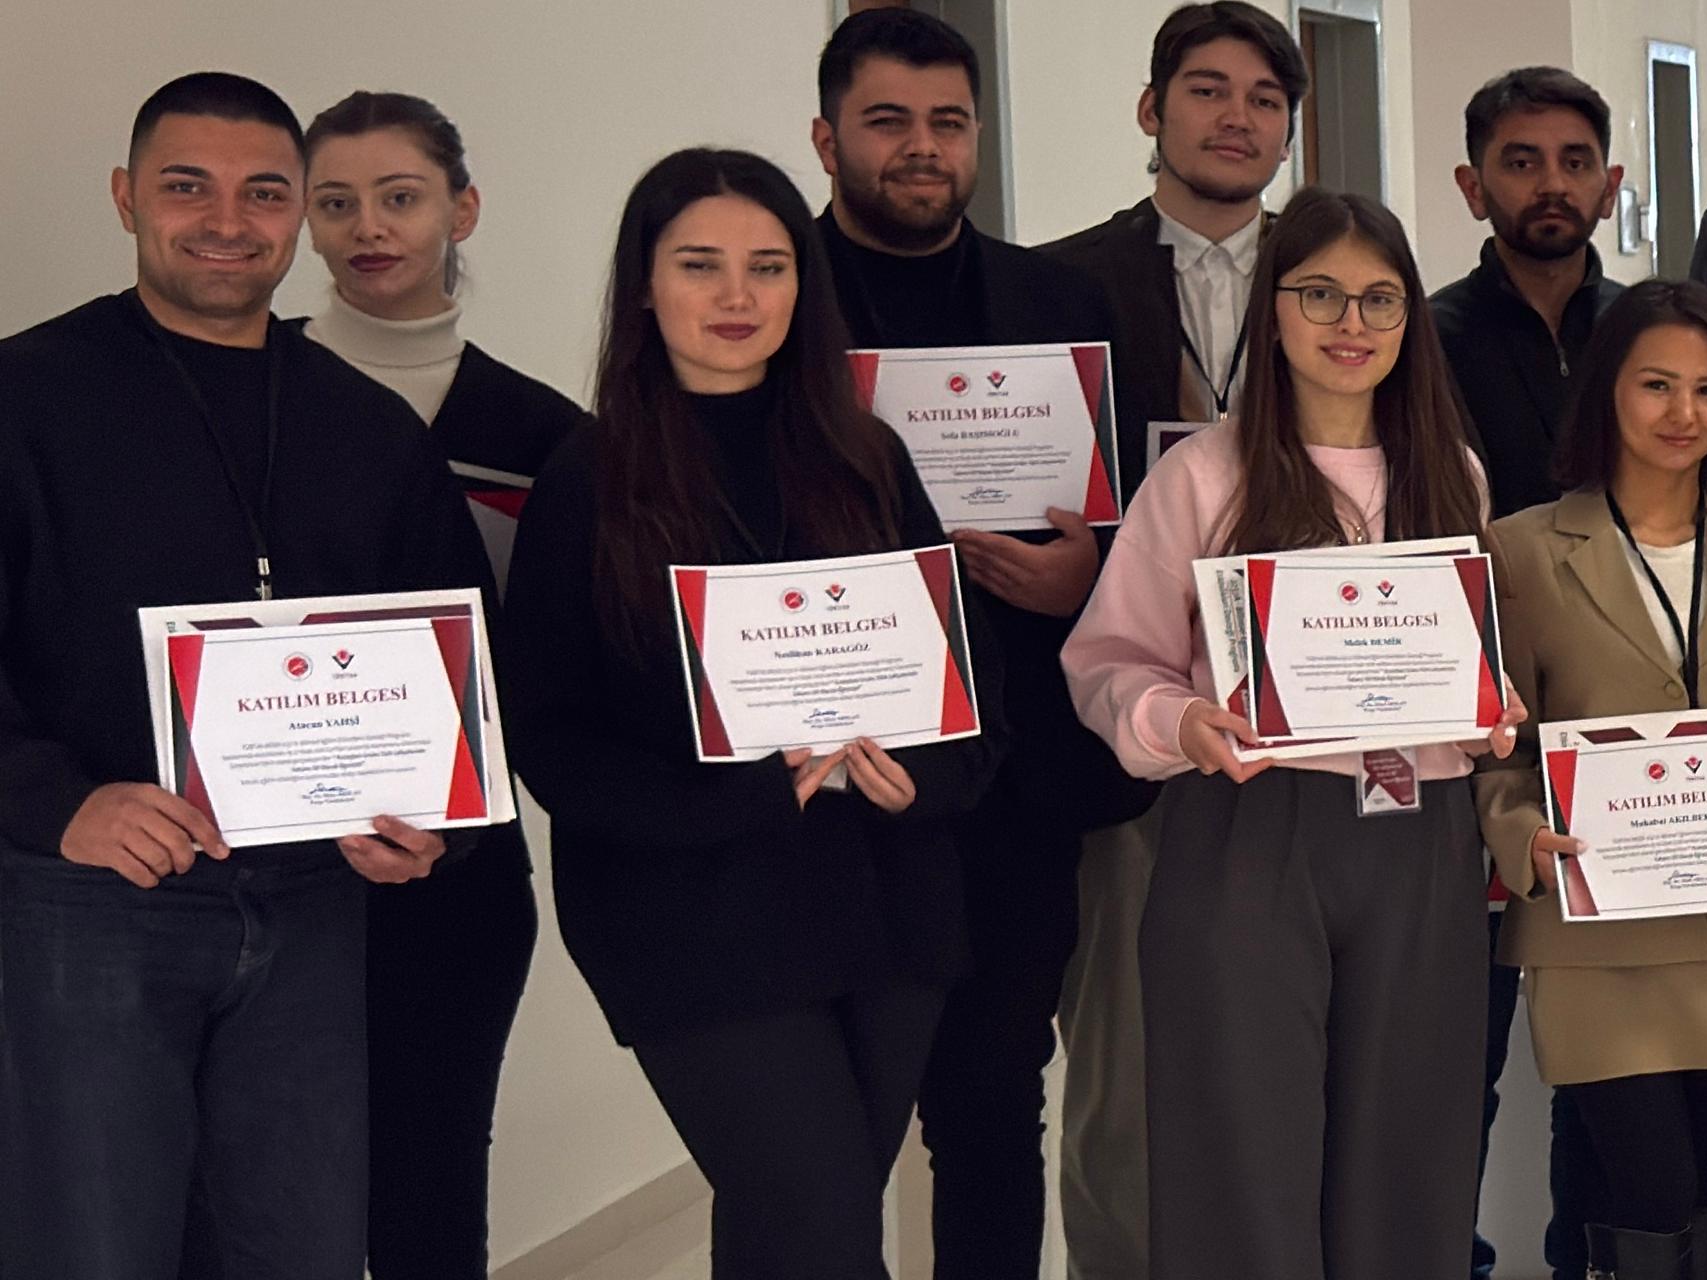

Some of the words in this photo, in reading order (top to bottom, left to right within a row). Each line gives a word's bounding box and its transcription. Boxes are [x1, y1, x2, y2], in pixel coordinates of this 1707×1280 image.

[908, 408, 977, 423] KATILIM
[982, 404, 1051, 420] BELGESİ
[741, 625, 817, 641] KATILIM
[823, 613, 897, 635] BELGESİ
[1303, 616, 1371, 630] KATILIM
[1374, 612, 1438, 628] BELGESİ
[238, 693, 320, 712] KATILIM
[327, 684, 407, 706] BELGESİ
[1608, 794, 1677, 812] KATILIM
